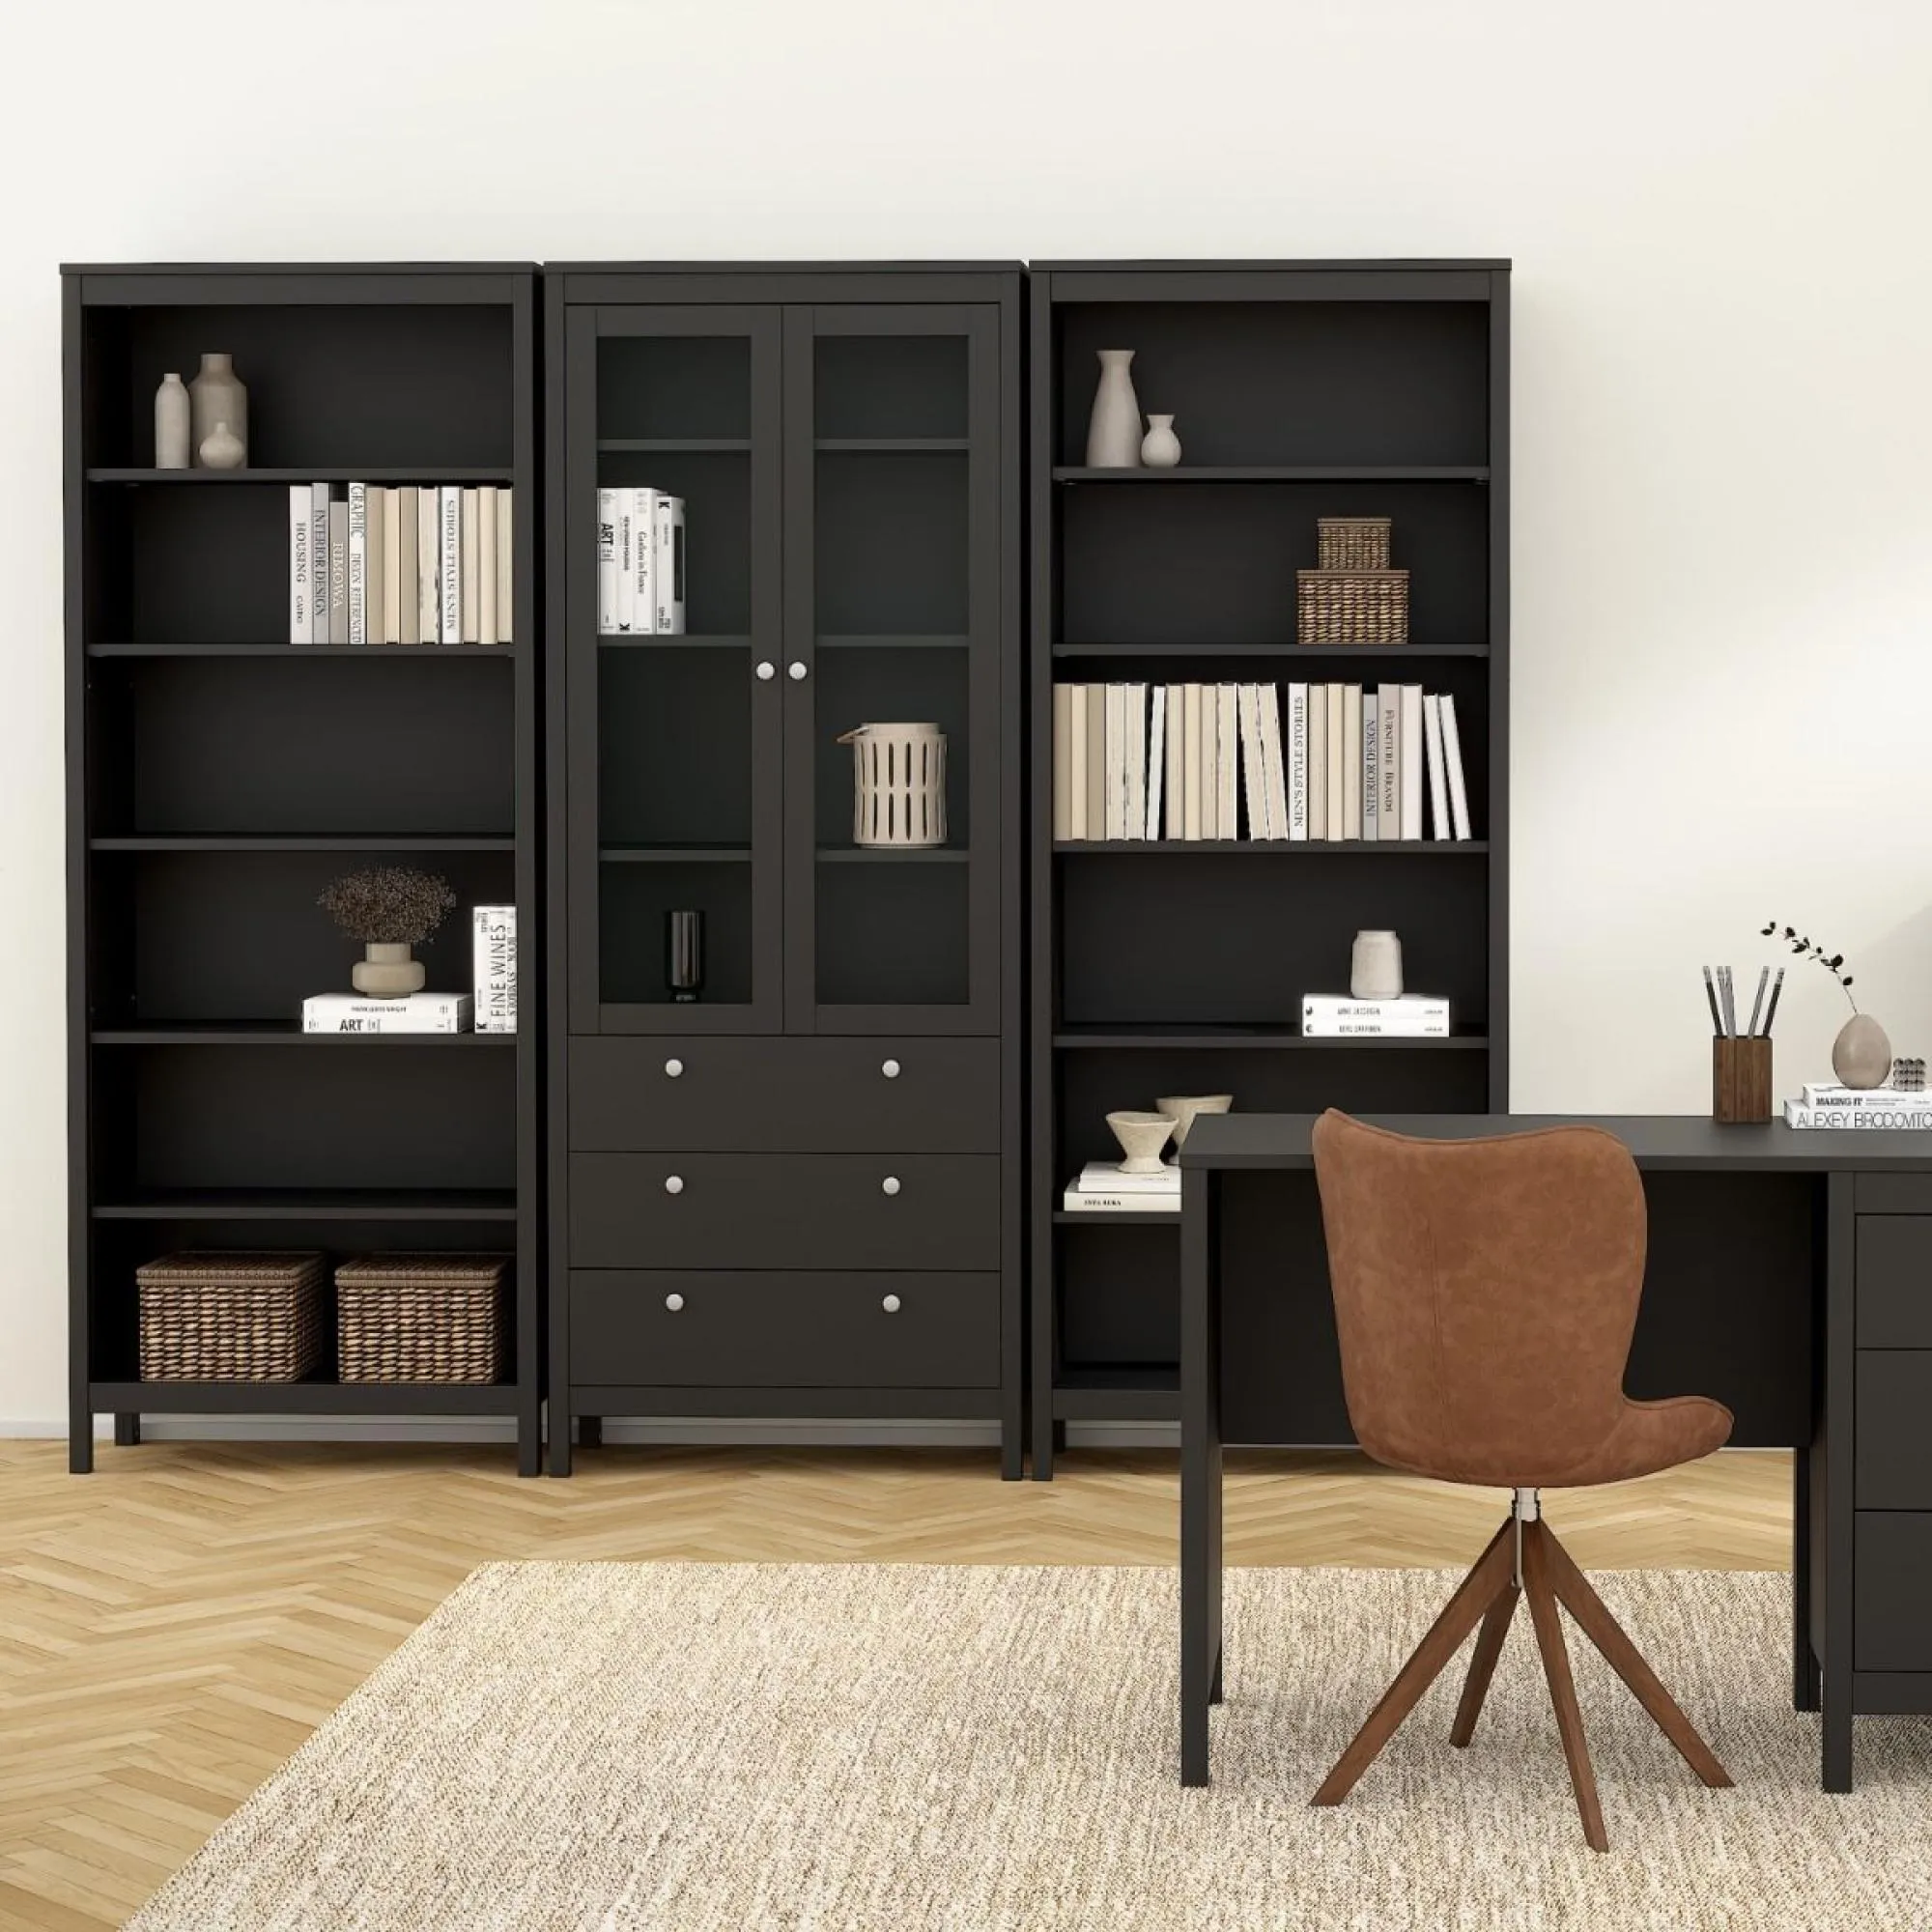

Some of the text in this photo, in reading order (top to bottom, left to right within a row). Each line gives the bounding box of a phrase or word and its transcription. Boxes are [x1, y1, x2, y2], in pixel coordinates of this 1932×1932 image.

[351, 485, 364, 539] GRAPHIC
[446, 499, 456, 551] STORIES
[601, 523, 614, 546] ART
[296, 522, 306, 583] HOUSING
[314, 509, 327, 616] INTERIOR DESIGN
[332, 542, 344, 609] RIMOWA
[446, 554, 456, 590] STYLE
[1293, 696, 1303, 827] MEN'S STYLE STORIES
[1366, 720, 1377, 816] INTERIOR DESIGN
[491, 924, 506, 977] WINES
[340, 1018, 364, 1031] ART
[491, 982, 506, 1017] FINE
[1797, 1112, 1851, 1128] ALEXEY
[1816, 1097, 1852, 1106] MAKING
[1853, 1097, 1863, 1106] IT
